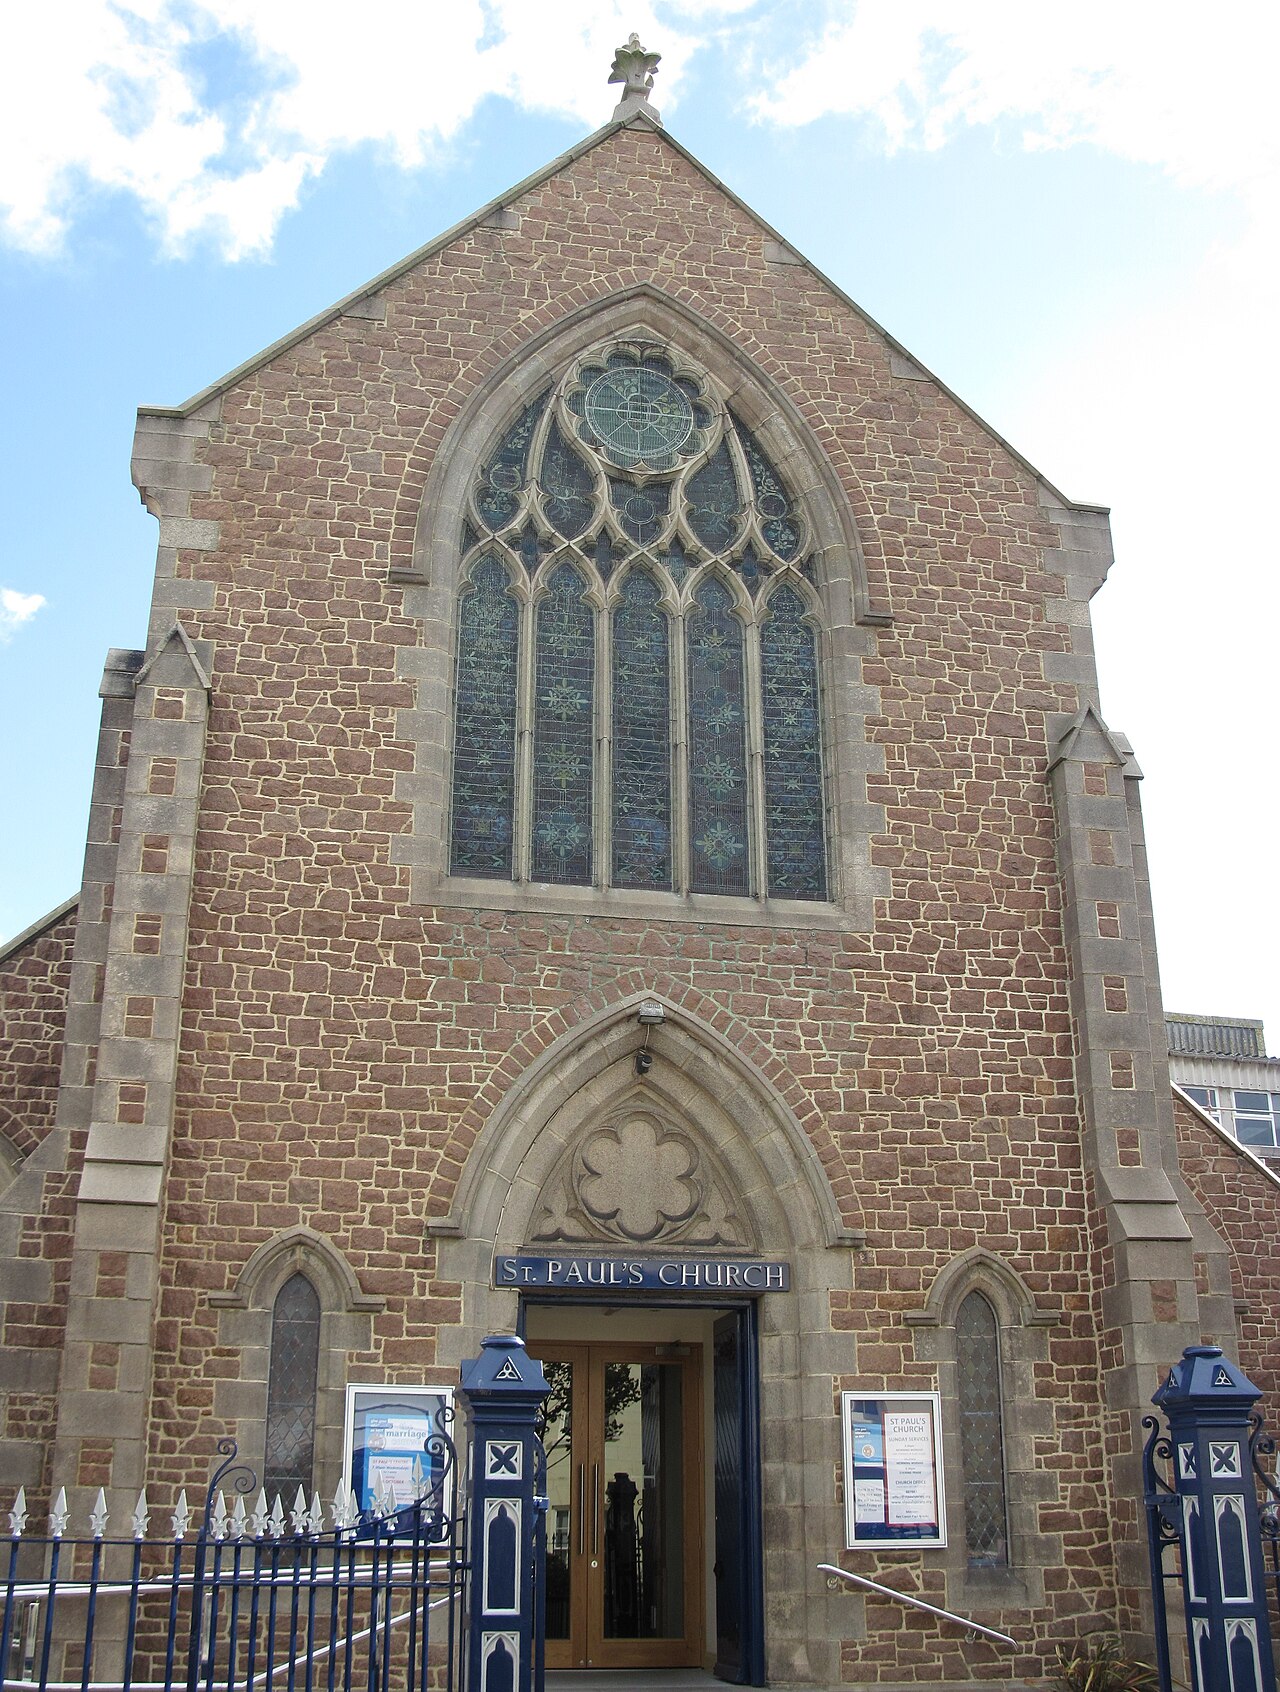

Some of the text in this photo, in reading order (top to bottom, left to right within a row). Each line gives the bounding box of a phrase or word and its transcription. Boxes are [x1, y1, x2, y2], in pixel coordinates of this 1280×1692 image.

[546, 1260, 644, 1284] PAUL'S
[658, 1264, 784, 1288] CHURCH
[385, 1430, 427, 1440] marriage
